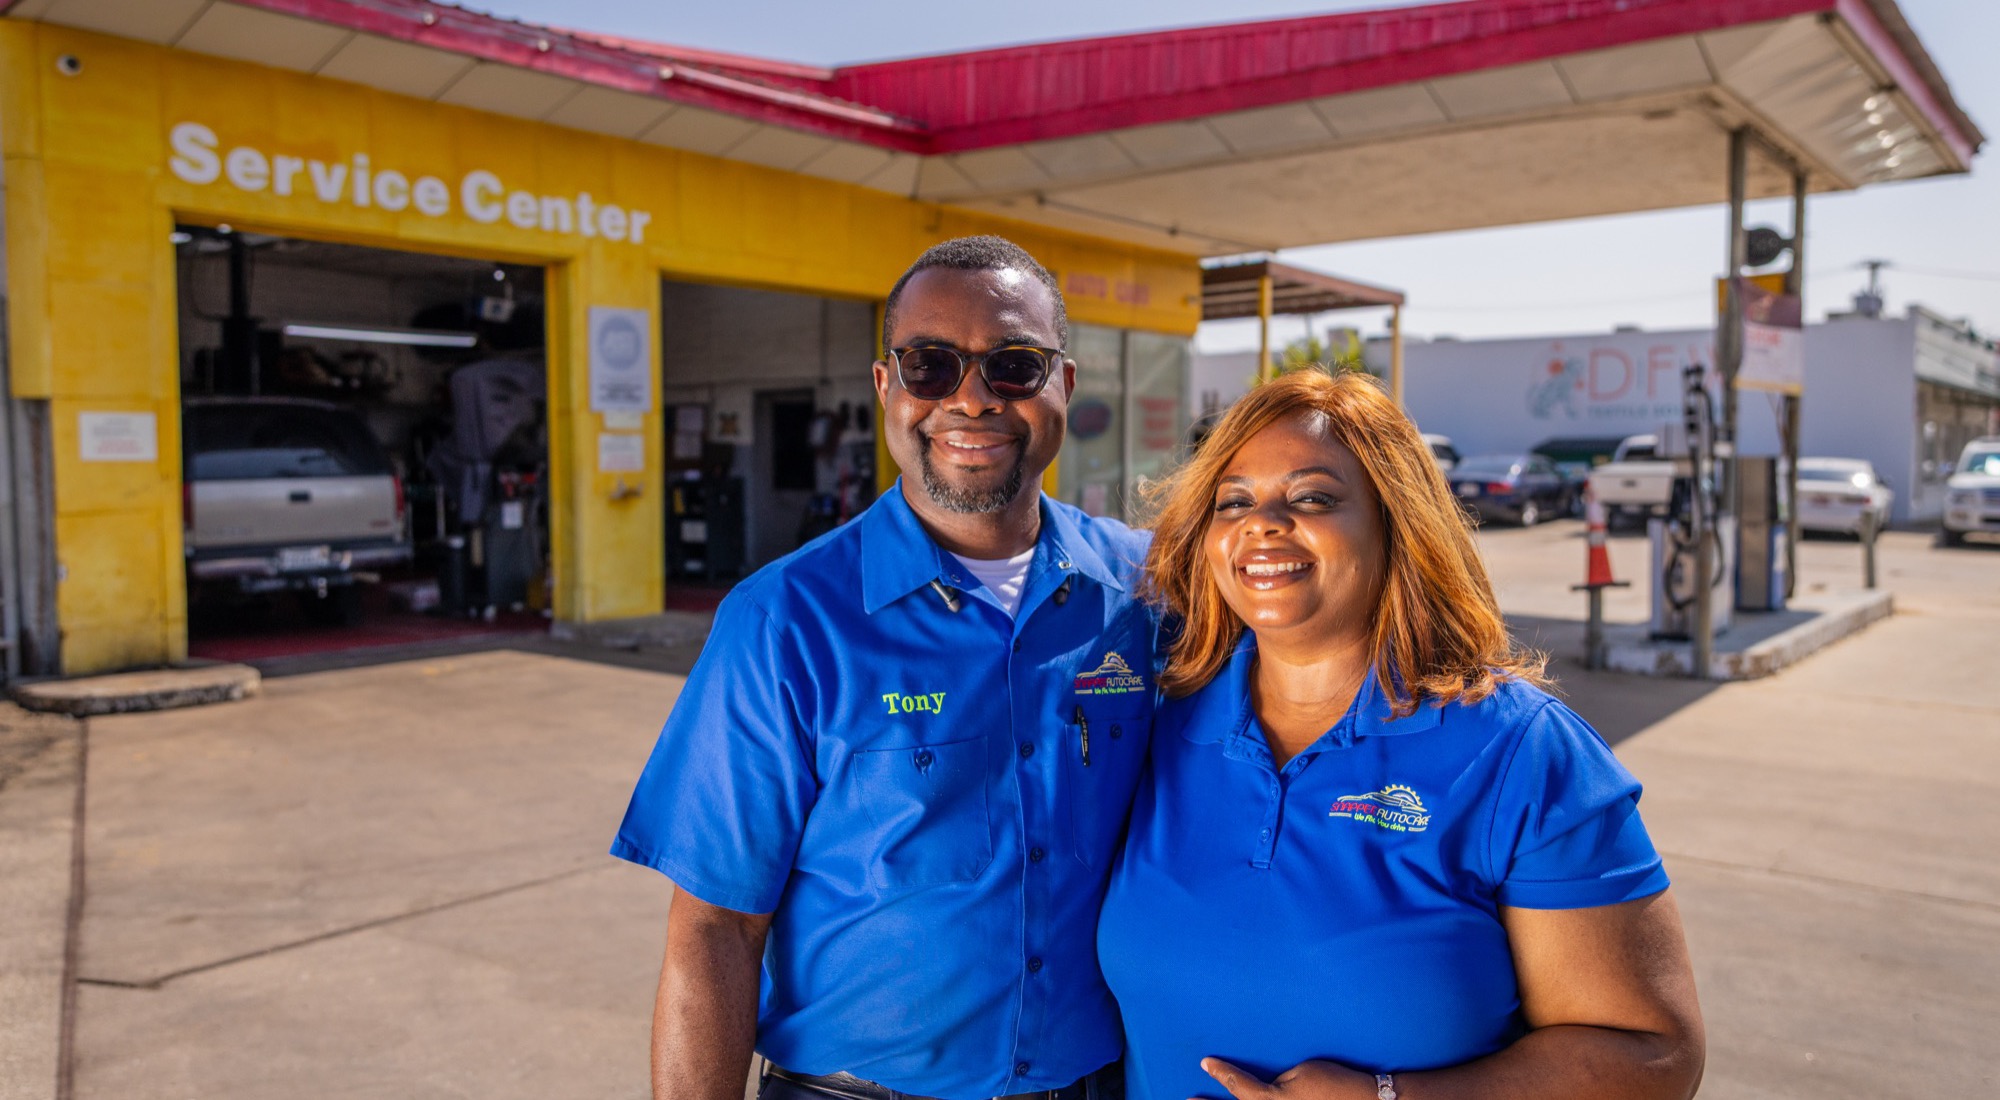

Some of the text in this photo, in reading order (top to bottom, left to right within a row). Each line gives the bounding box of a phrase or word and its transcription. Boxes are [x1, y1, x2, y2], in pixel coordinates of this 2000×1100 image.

[168, 121, 651, 245] Service Center
[1107, 676, 1144, 687] AUTOCARE
[882, 692, 946, 714] Tony
[1376, 808, 1431, 826] AUTOCARE
[1377, 818, 1390, 829] You
